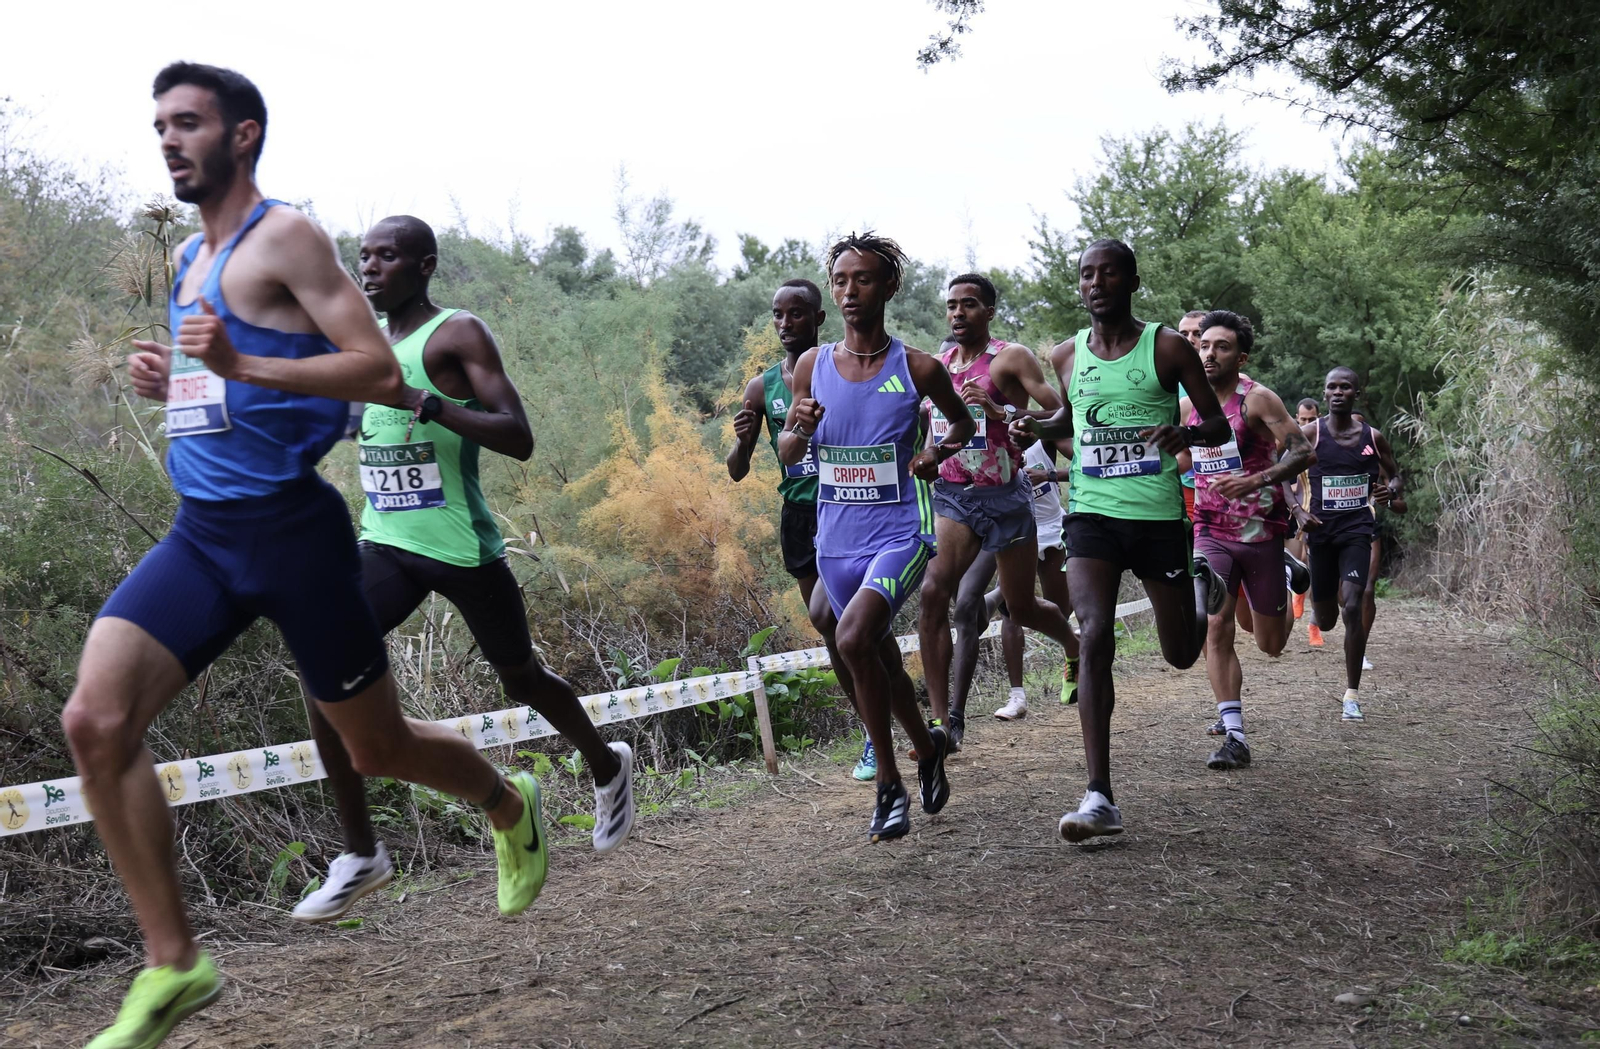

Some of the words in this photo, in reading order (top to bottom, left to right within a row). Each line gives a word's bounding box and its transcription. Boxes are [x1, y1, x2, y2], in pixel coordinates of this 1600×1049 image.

[1108, 409, 1149, 419] MENORCA
[830, 449, 878, 462] ITÁLICA
[1093, 444, 1145, 465] 1219
[370, 467, 423, 491] 1218
[833, 467, 876, 483] CRIPPA
[1328, 486, 1364, 498] KIPLANGAT
[266, 776, 285, 786] Sevilla
[199, 787, 220, 798] Sevilla
[46, 813, 70, 825] Sevilla
